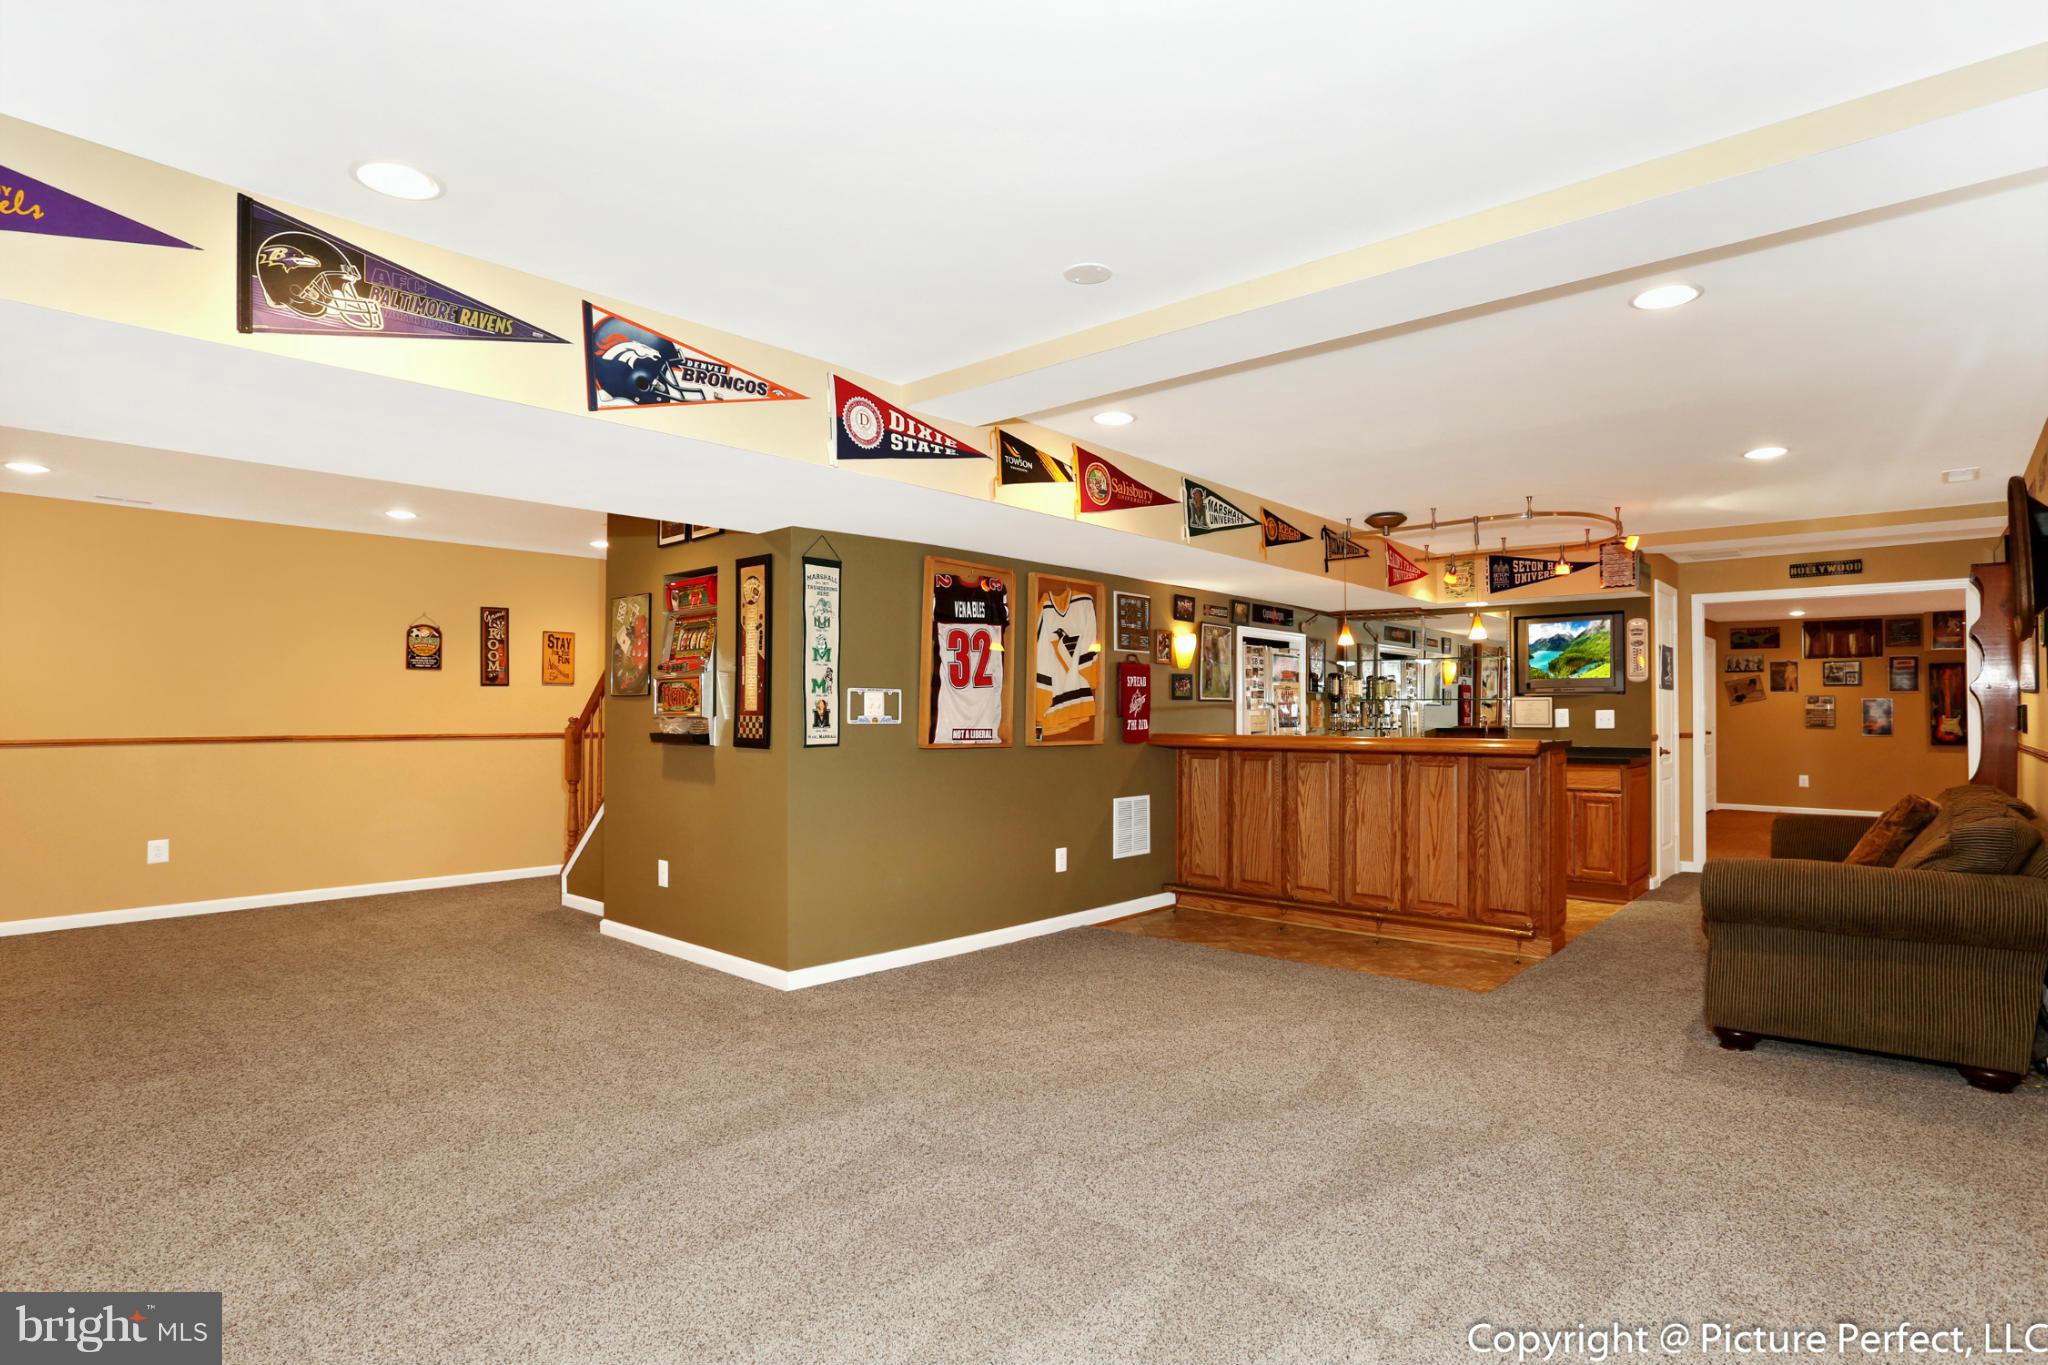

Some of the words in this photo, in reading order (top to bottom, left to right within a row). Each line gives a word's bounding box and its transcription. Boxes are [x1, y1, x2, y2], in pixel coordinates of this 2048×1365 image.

[370, 267, 428, 296] AFC
[369, 285, 459, 323] BALTIMORE
[459, 307, 514, 336] RAVENS
[686, 358, 727, 375] DENVER
[681, 367, 768, 397] BRONCOS
[888, 408, 958, 448] DIXIE
[890, 432, 958, 456] STATE
[1004, 455, 1033, 470] TOWSON
[1111, 477, 1153, 503] Salisbury
[1207, 498, 1245, 520] MARSHALL
[1512, 559, 1544, 573] SETON
[1790, 562, 1862, 576] HOLLYWOOD
[806, 573, 838, 585] MARSHALL
[1514, 570, 1556, 585] UNIVERS
[954, 600, 986, 618] VENABLES
[487, 627, 501, 672] ROOM
[547, 633, 572, 650] STAY
[558, 655, 570, 665] FUN
[946, 628, 994, 690] 32
